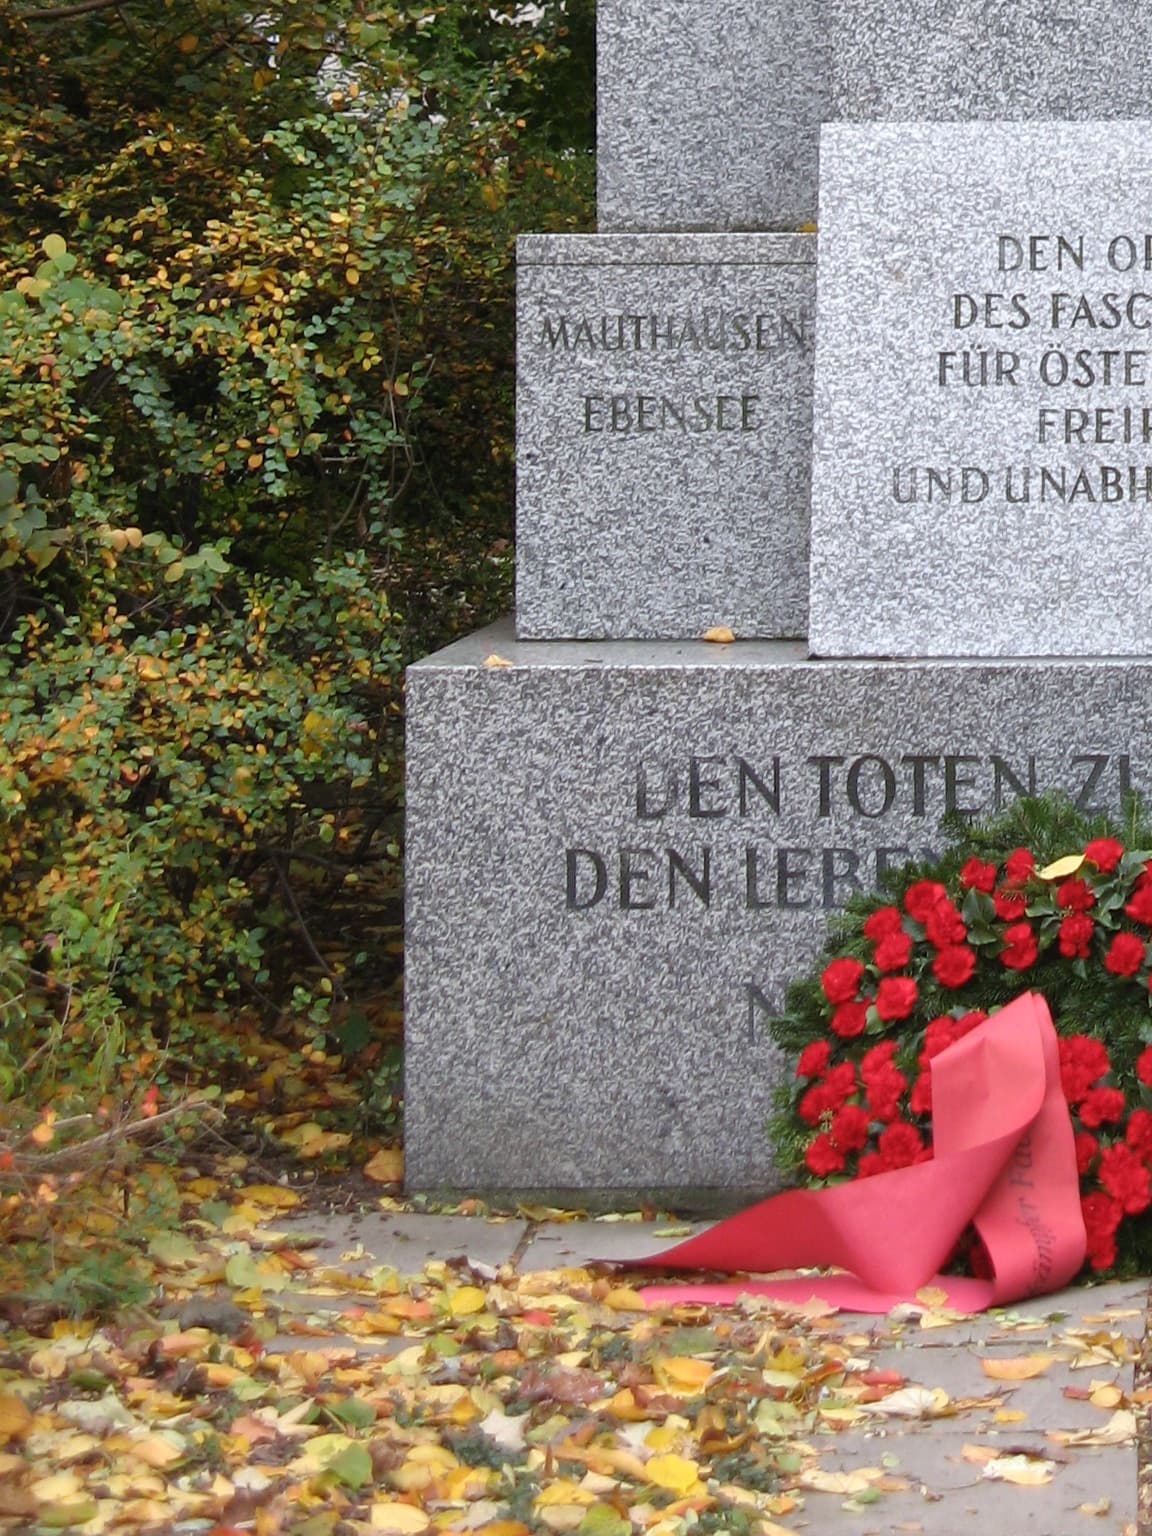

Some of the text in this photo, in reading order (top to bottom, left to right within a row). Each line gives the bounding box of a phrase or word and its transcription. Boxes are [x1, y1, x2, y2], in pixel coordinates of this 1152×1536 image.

[999, 235, 1084, 272] DEN
[953, 293, 1031, 329] DES
[540, 314, 806, 352] MAUTHAUSEN
[938, 344, 1021, 387] FÜR
[582, 394, 760, 432] EBENSEE
[892, 467, 990, 504] UND
[636, 755, 780, 817] DEN
[806, 753, 1036, 817] TOTEN
[565, 848, 711, 909] DEN
[745, 848, 940, 909] LEB
